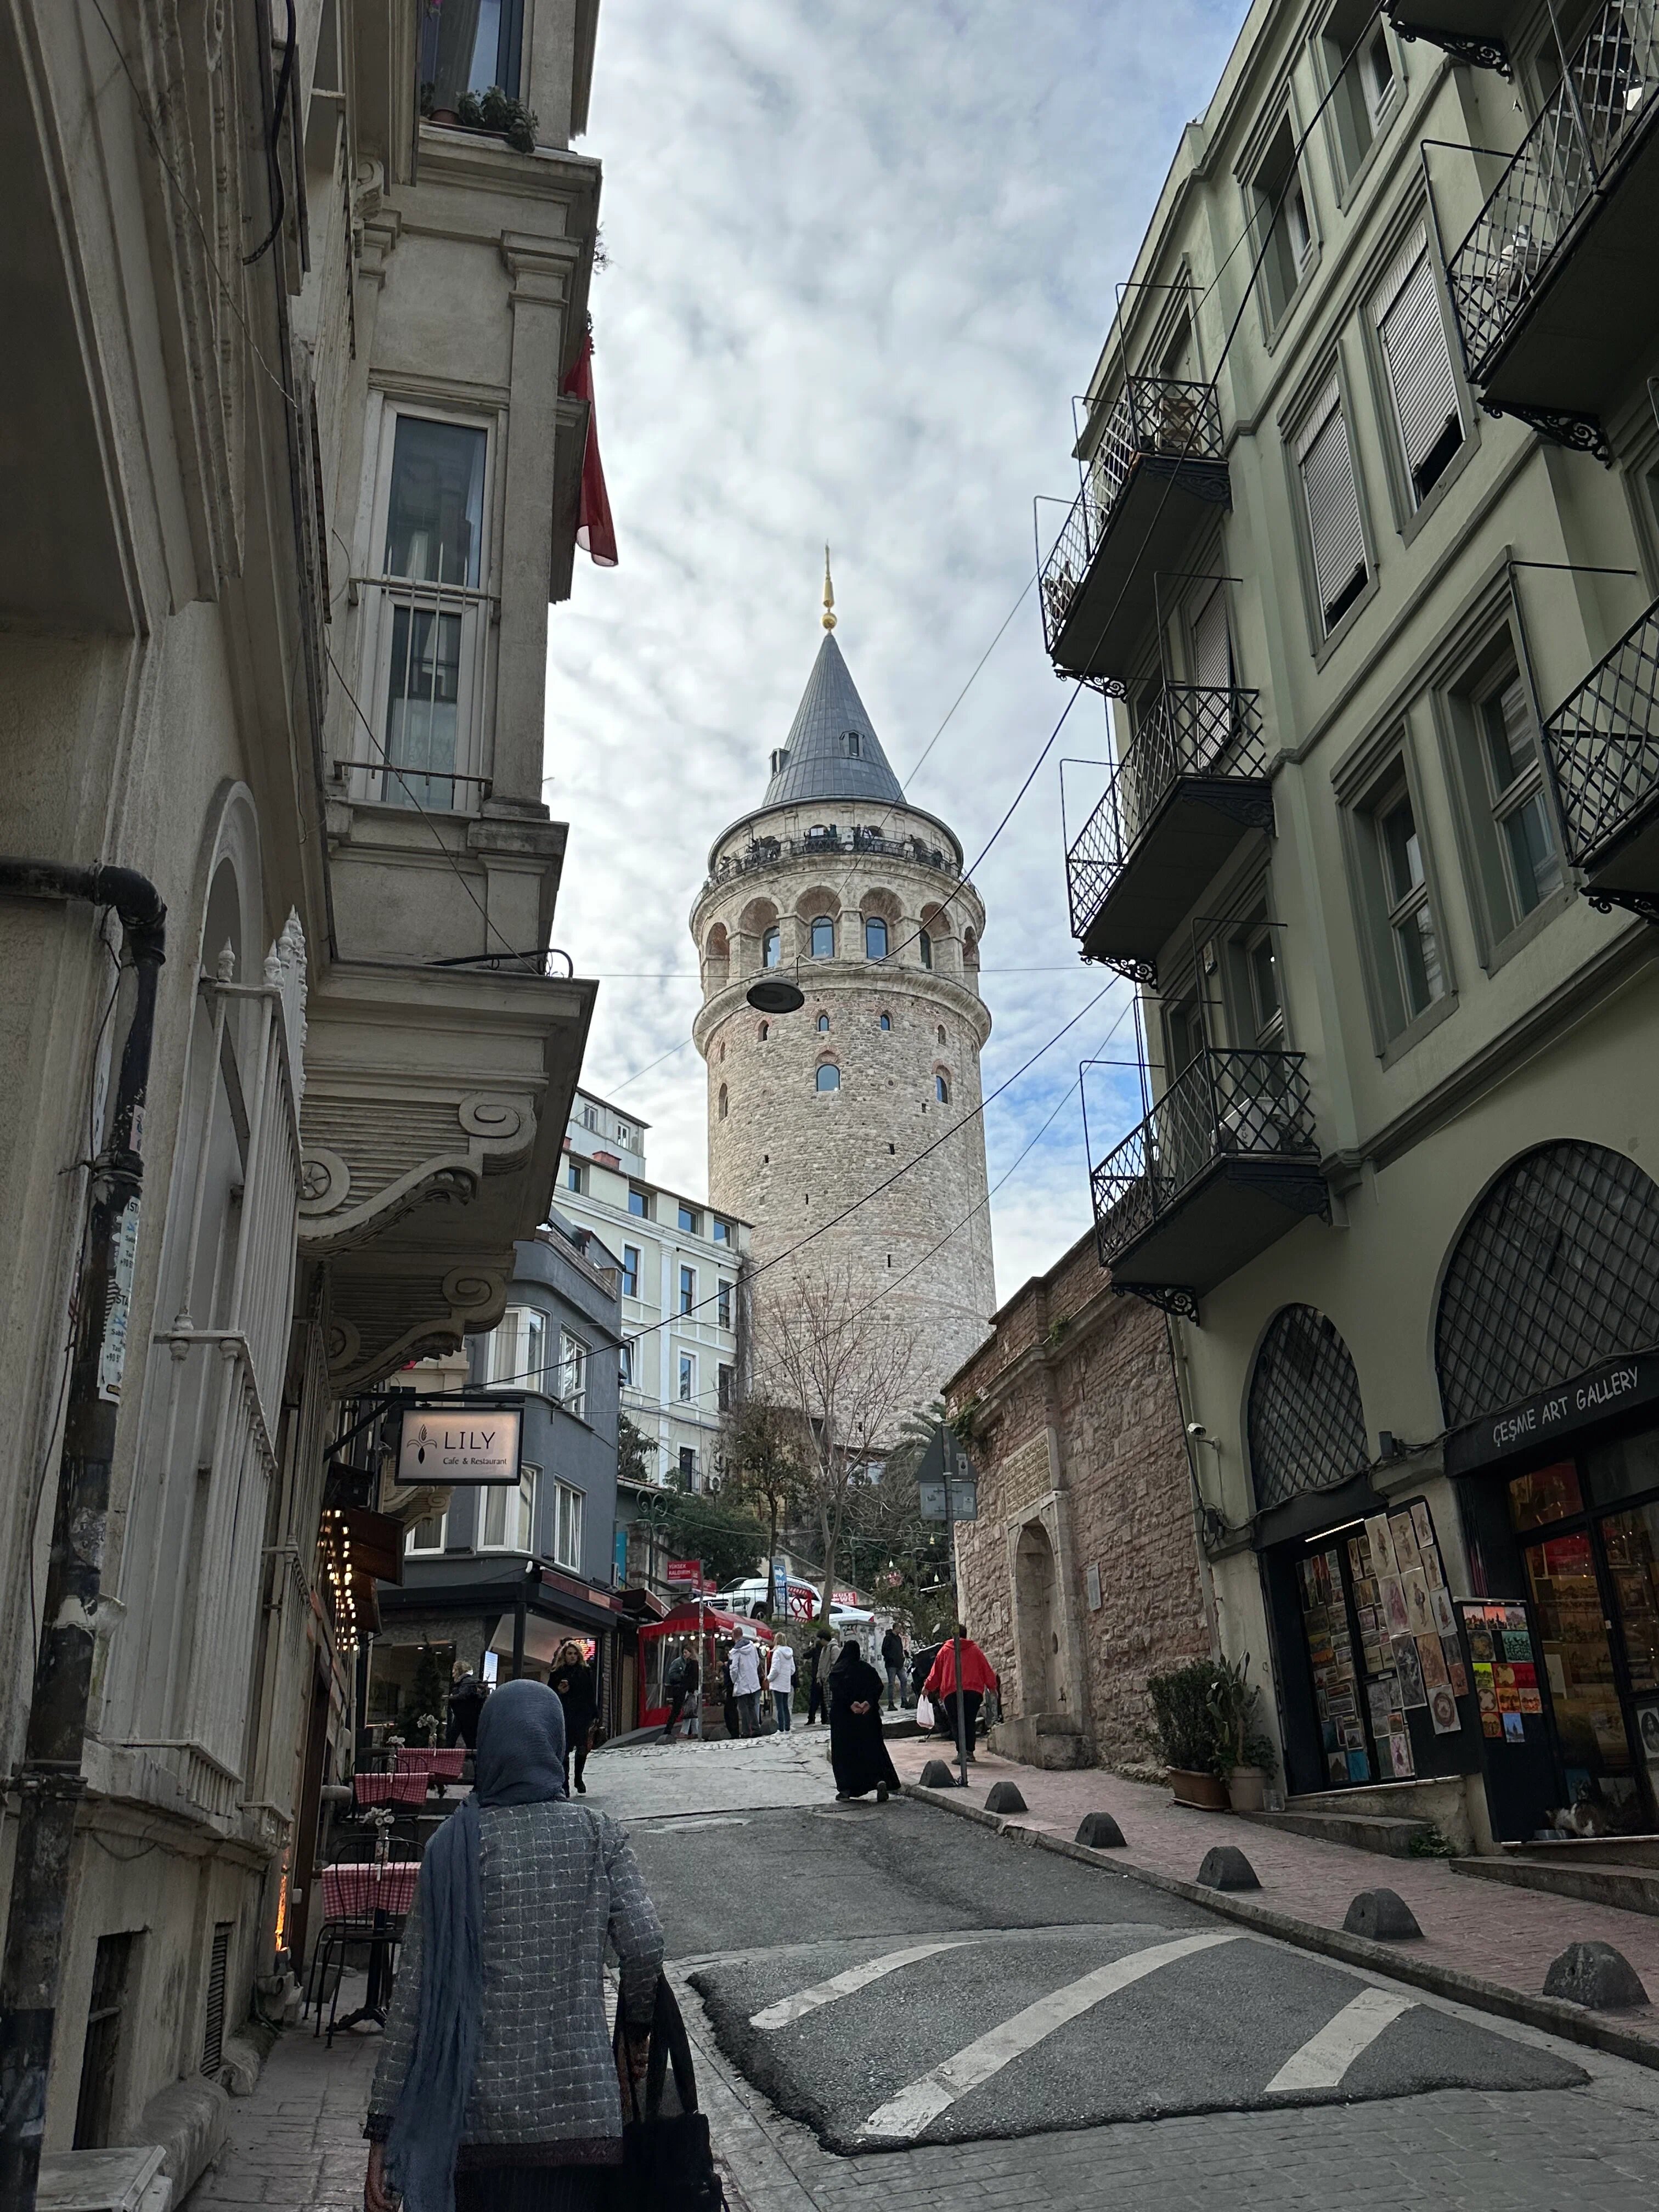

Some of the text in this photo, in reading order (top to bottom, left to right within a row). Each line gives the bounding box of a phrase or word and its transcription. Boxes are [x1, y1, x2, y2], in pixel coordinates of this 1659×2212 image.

[1493, 1367, 1638, 1447] ÇEŞME ART GALLERY
[444, 1431, 496, 1449] LILY
